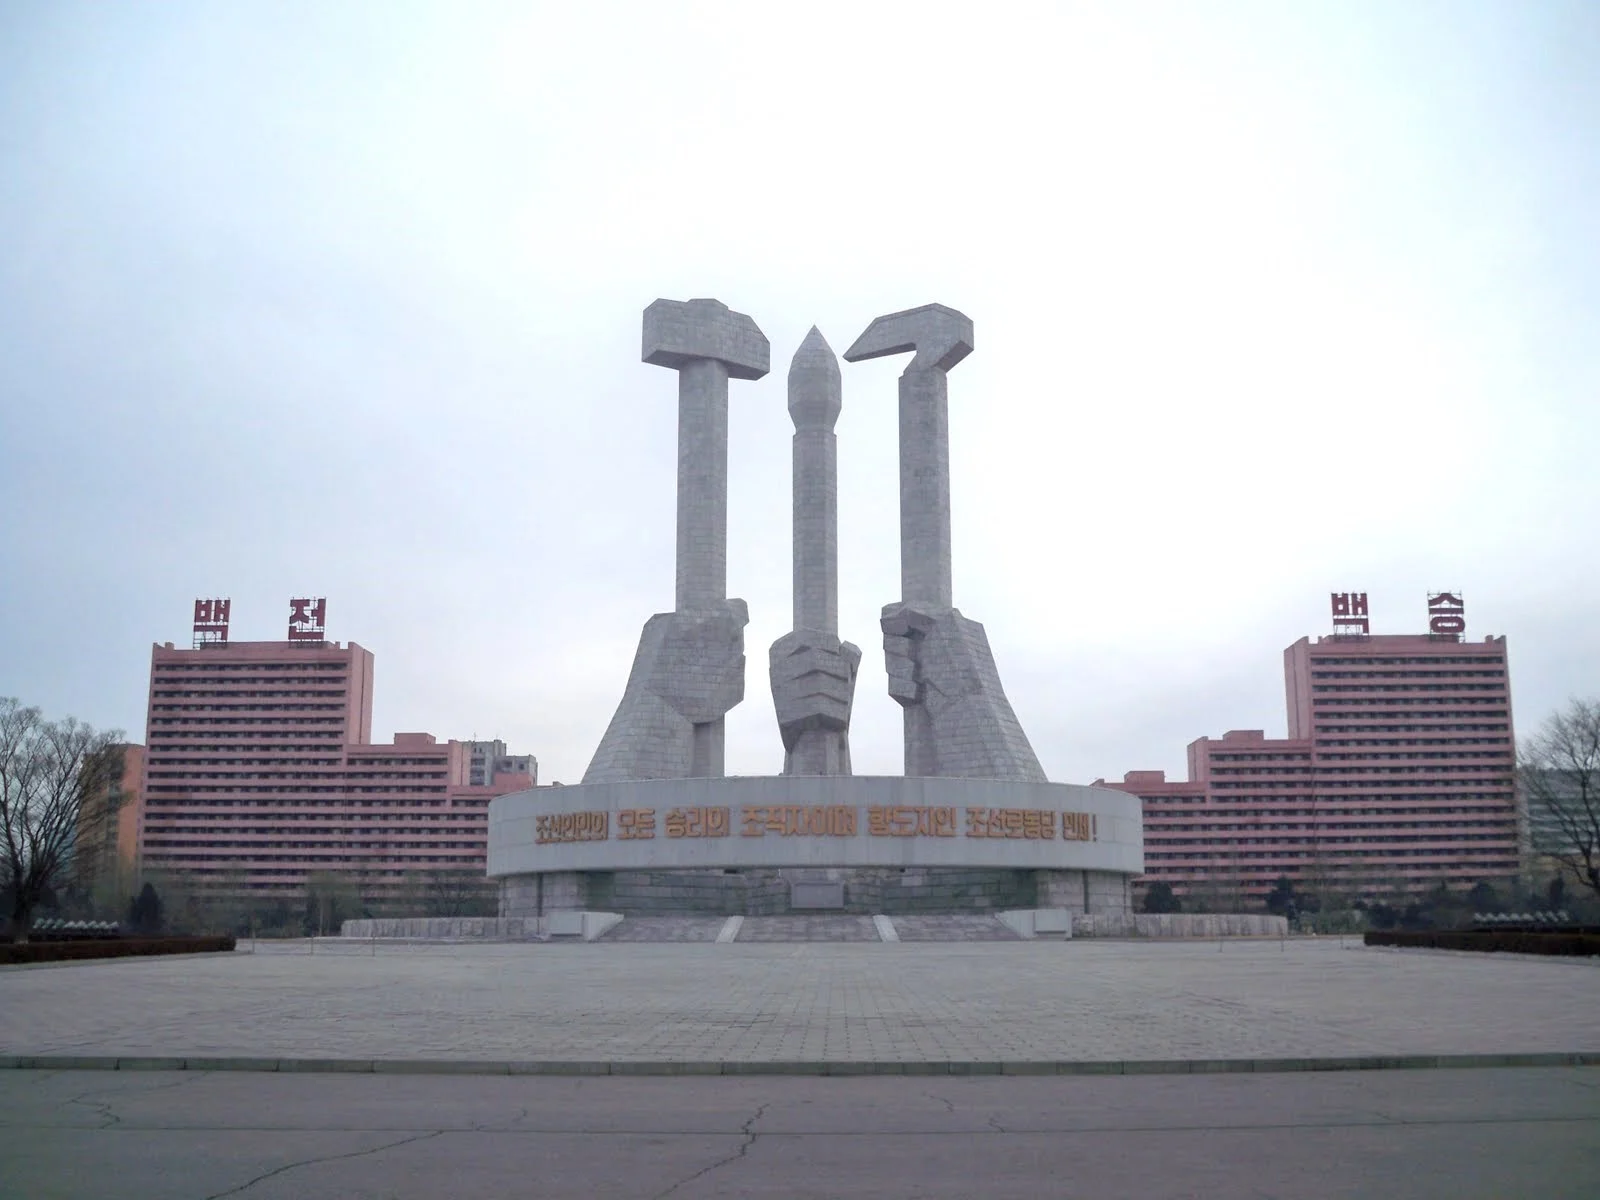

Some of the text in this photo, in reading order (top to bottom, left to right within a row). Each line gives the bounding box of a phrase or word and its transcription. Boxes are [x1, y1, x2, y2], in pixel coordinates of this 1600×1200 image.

[535, 811, 608, 844] 조선인민의
[616, 808, 656, 840] 모든
[665, 807, 729, 838] 승리의
[741, 806, 857, 837] 조직자이며
[965, 808, 1056, 840] 조선로동당
[1062, 812, 1097, 842] 만세!
